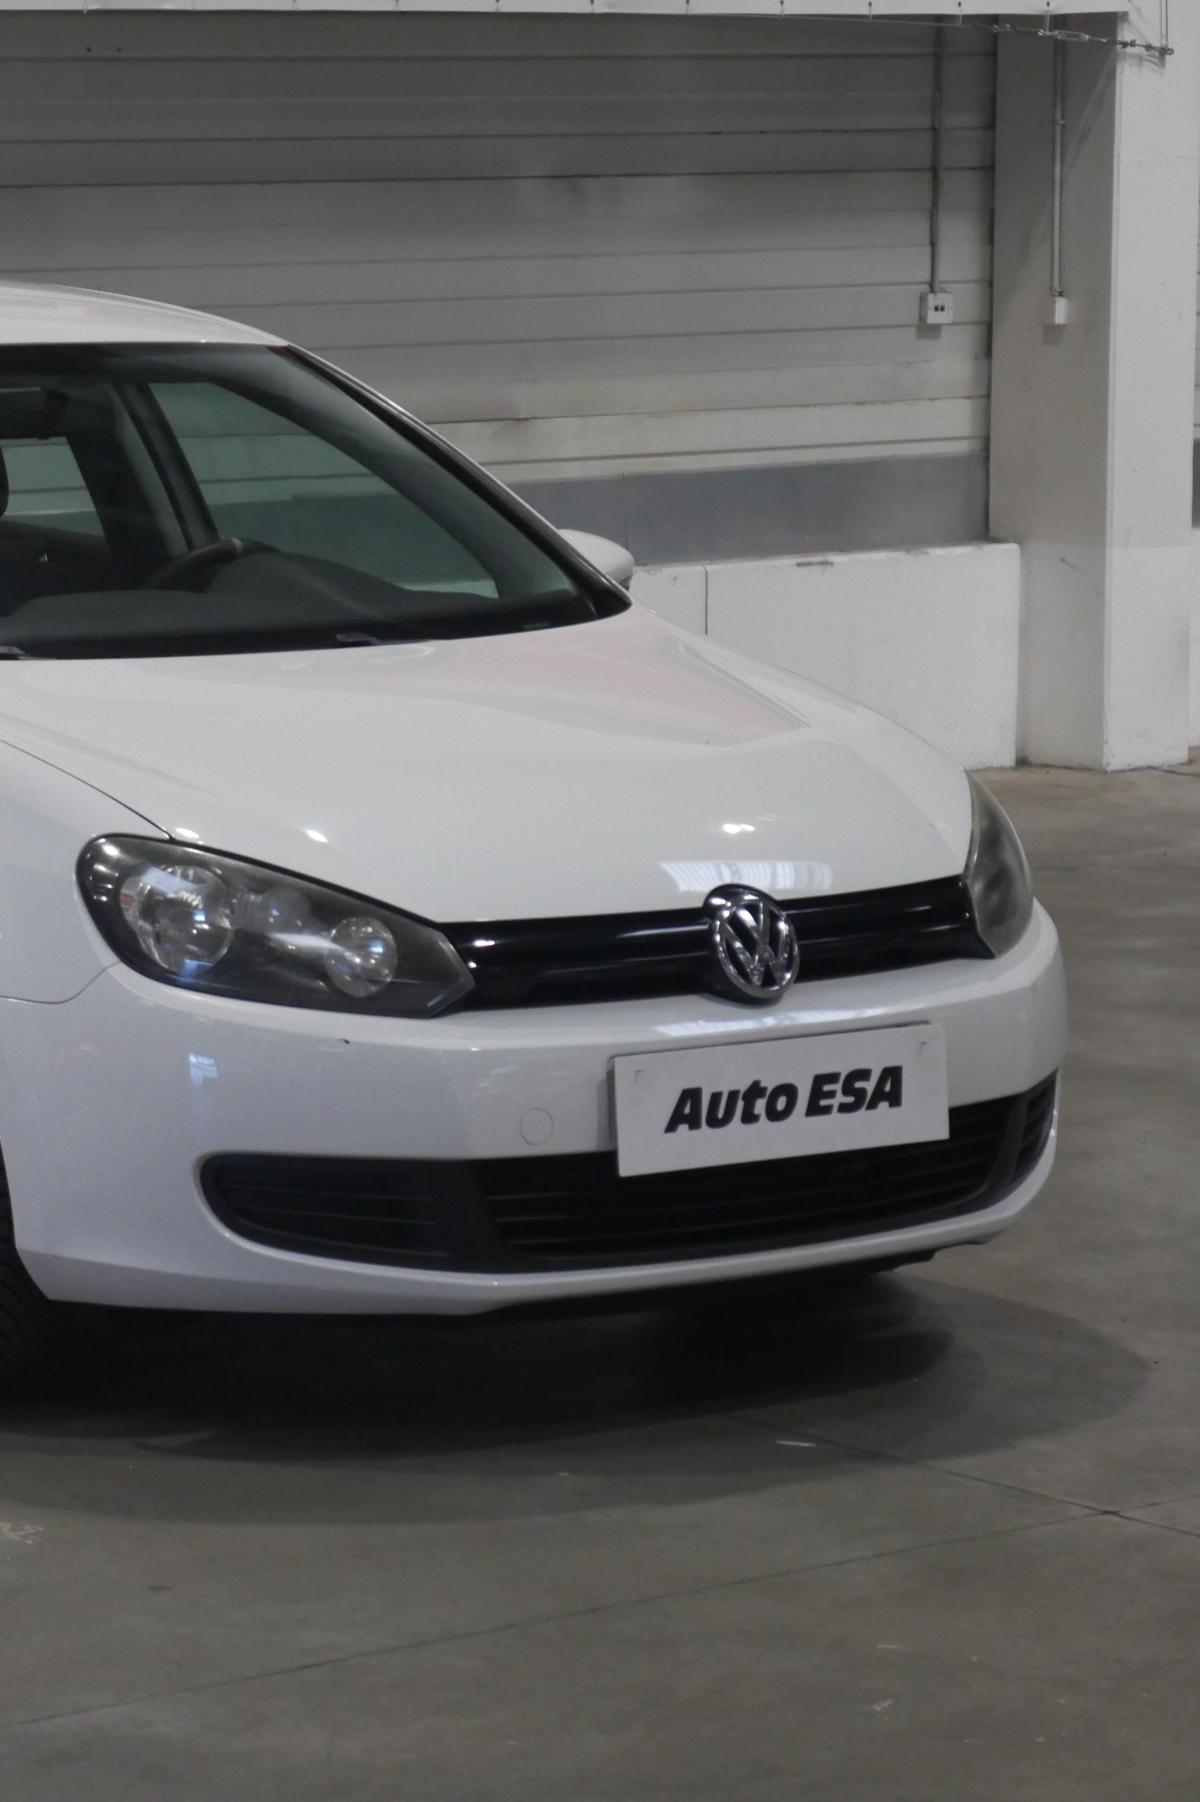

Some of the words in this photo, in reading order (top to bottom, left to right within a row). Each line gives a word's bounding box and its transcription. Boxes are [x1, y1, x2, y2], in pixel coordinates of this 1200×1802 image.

[711, 890, 799, 999] VW
[663, 1080, 799, 1133] Auto
[804, 1065, 904, 1118] ESA
